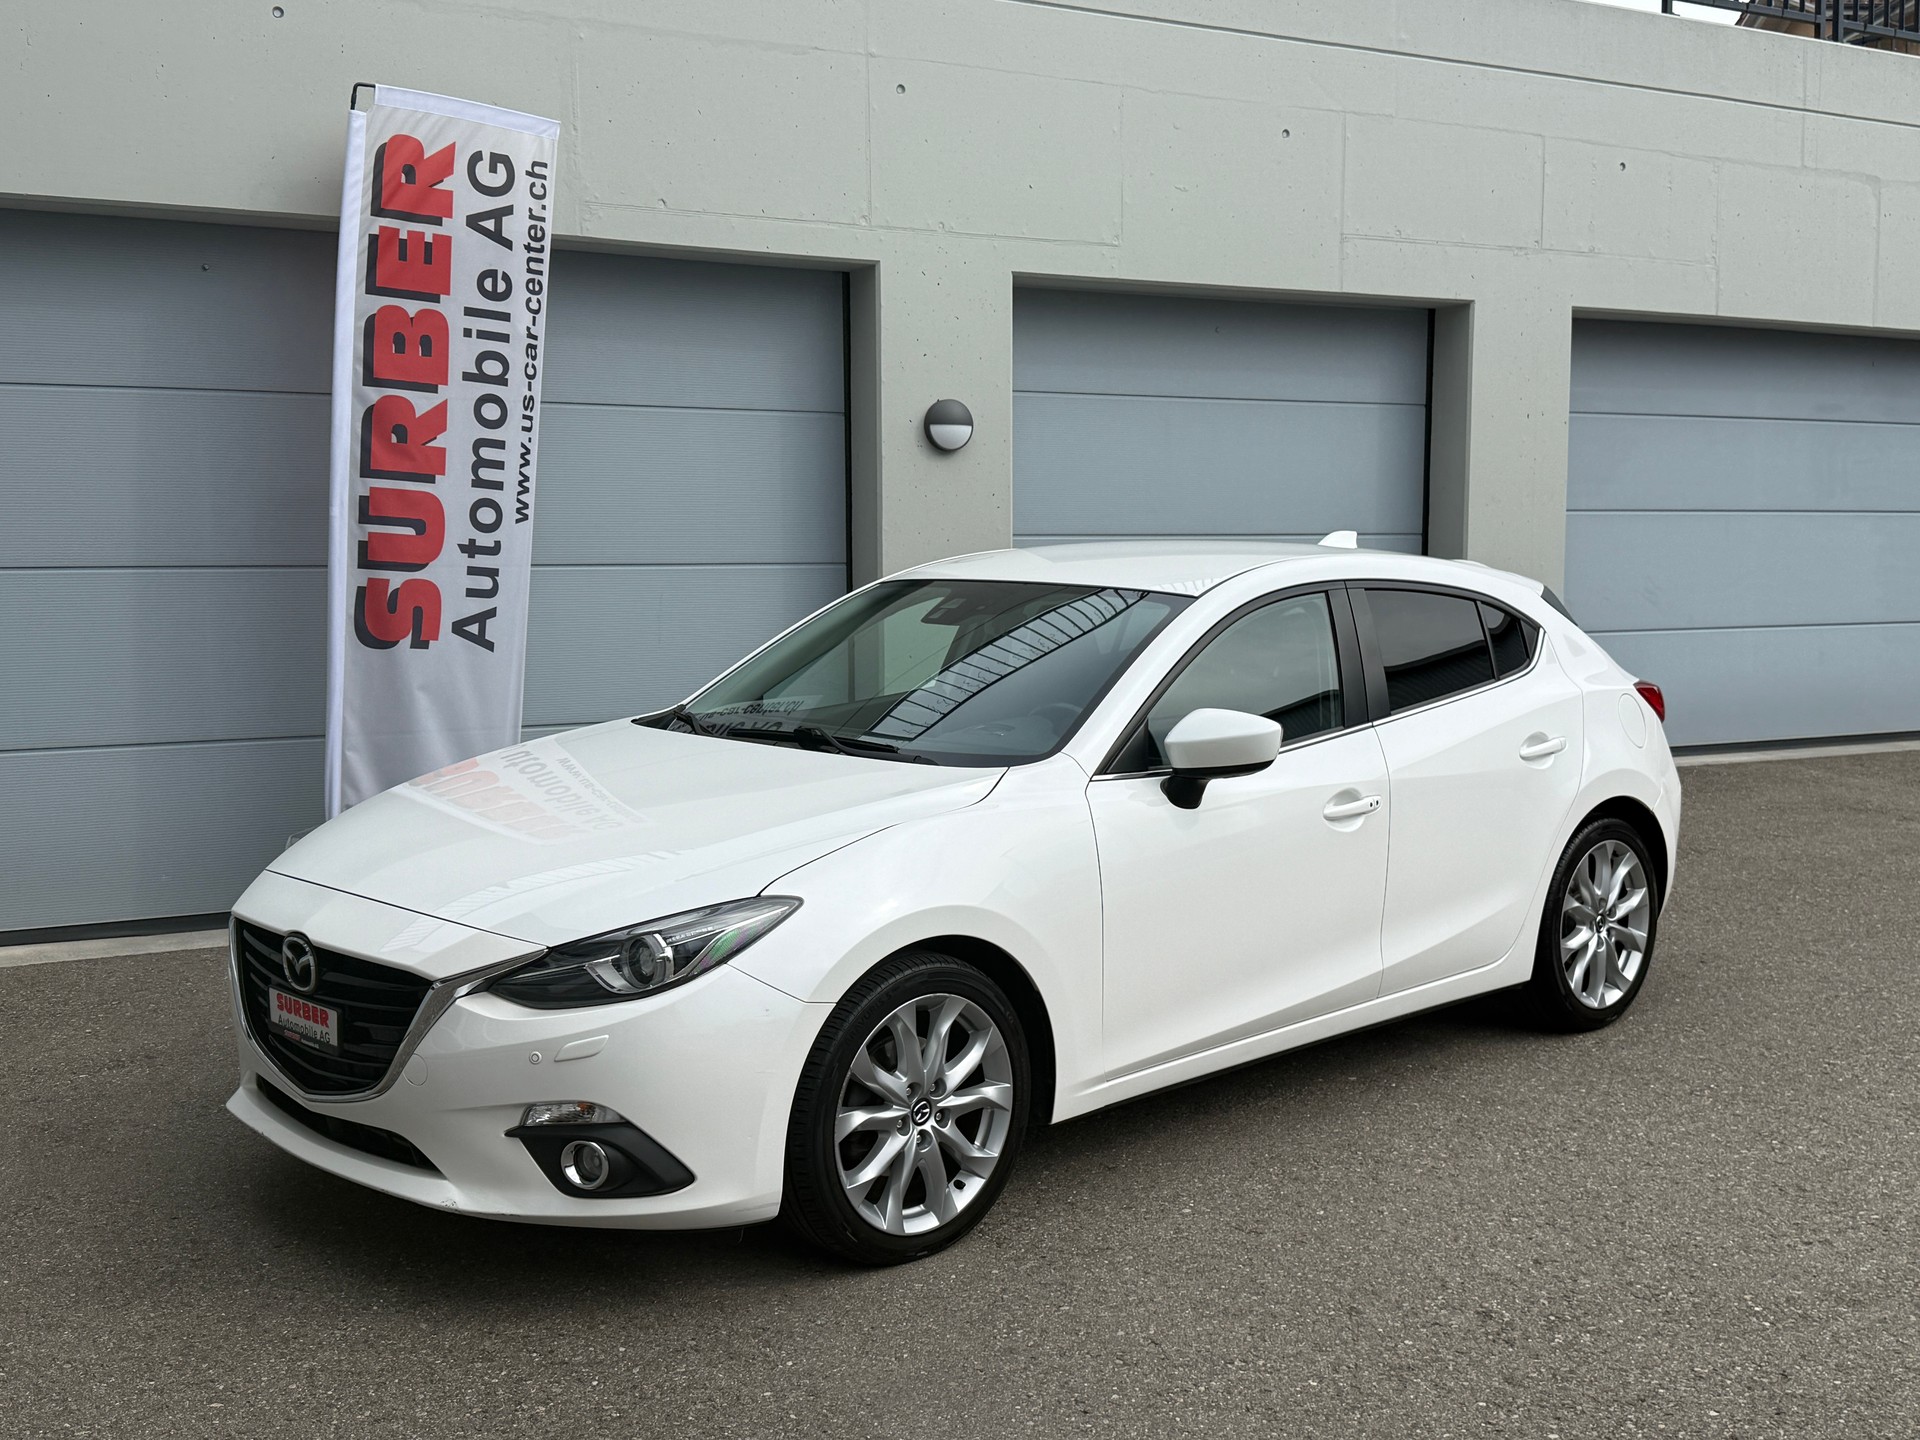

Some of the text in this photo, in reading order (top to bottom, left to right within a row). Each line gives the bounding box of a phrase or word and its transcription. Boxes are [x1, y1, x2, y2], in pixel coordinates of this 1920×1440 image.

[354, 133, 457, 650] SURBER
[451, 149, 516, 653] Automobile AG
[515, 160, 548, 525] www.us-car-center.ch
[276, 992, 330, 1029] SURBER
[277, 1014, 318, 1040] Automobile
[318, 1030, 331, 1044] AG
